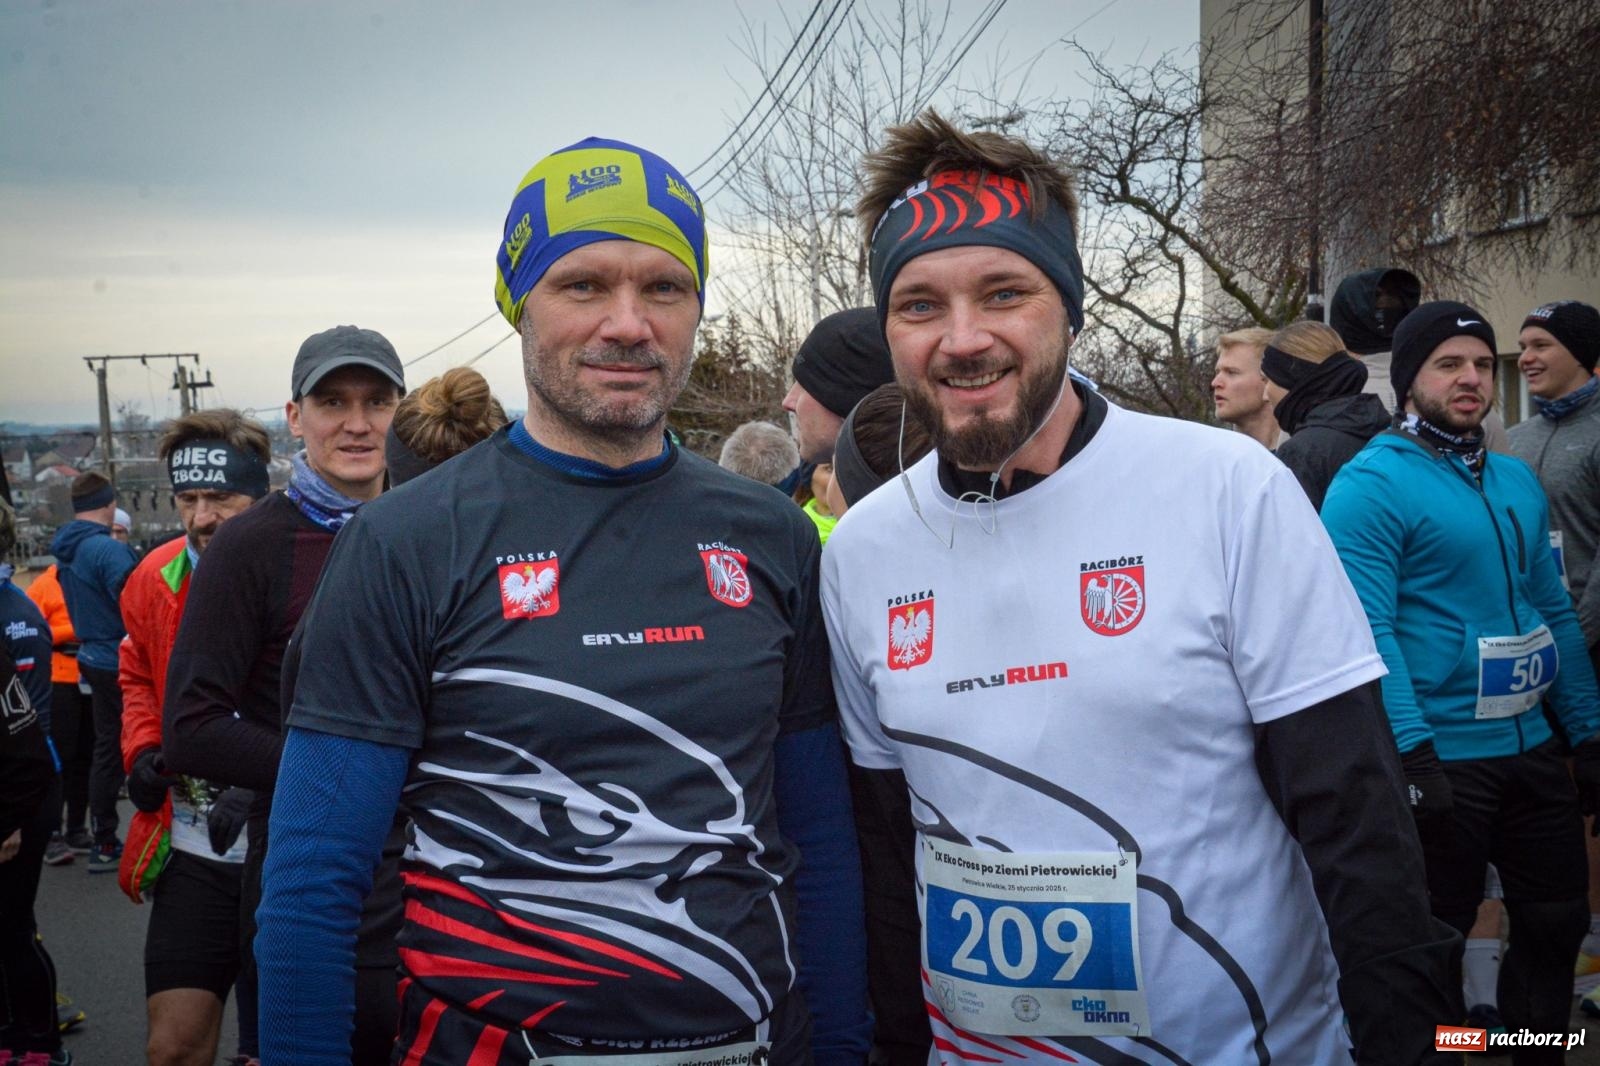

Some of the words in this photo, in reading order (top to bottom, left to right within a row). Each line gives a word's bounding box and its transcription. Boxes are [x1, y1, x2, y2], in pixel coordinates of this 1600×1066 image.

[172, 447, 228, 467] BIEG
[172, 465, 226, 484] ZBÓJA
[496, 550, 557, 565] POLSKA
[1080, 555, 1144, 572] RACIBÓRZ
[888, 589, 934, 607] POLSKA
[1509, 653, 1543, 691] 50
[935, 851, 943, 862] IX
[943, 853, 957, 867] Eko
[957, 856, 980, 871] Cross
[981, 863, 994, 876] po
[995, 864, 1029, 876] Ziemi
[1031, 864, 1117, 879] Pietrowickiej
[1007, 884, 1016, 892] 25
[1016, 884, 1045, 894] stycznia
[951, 898, 1093, 982] 209
